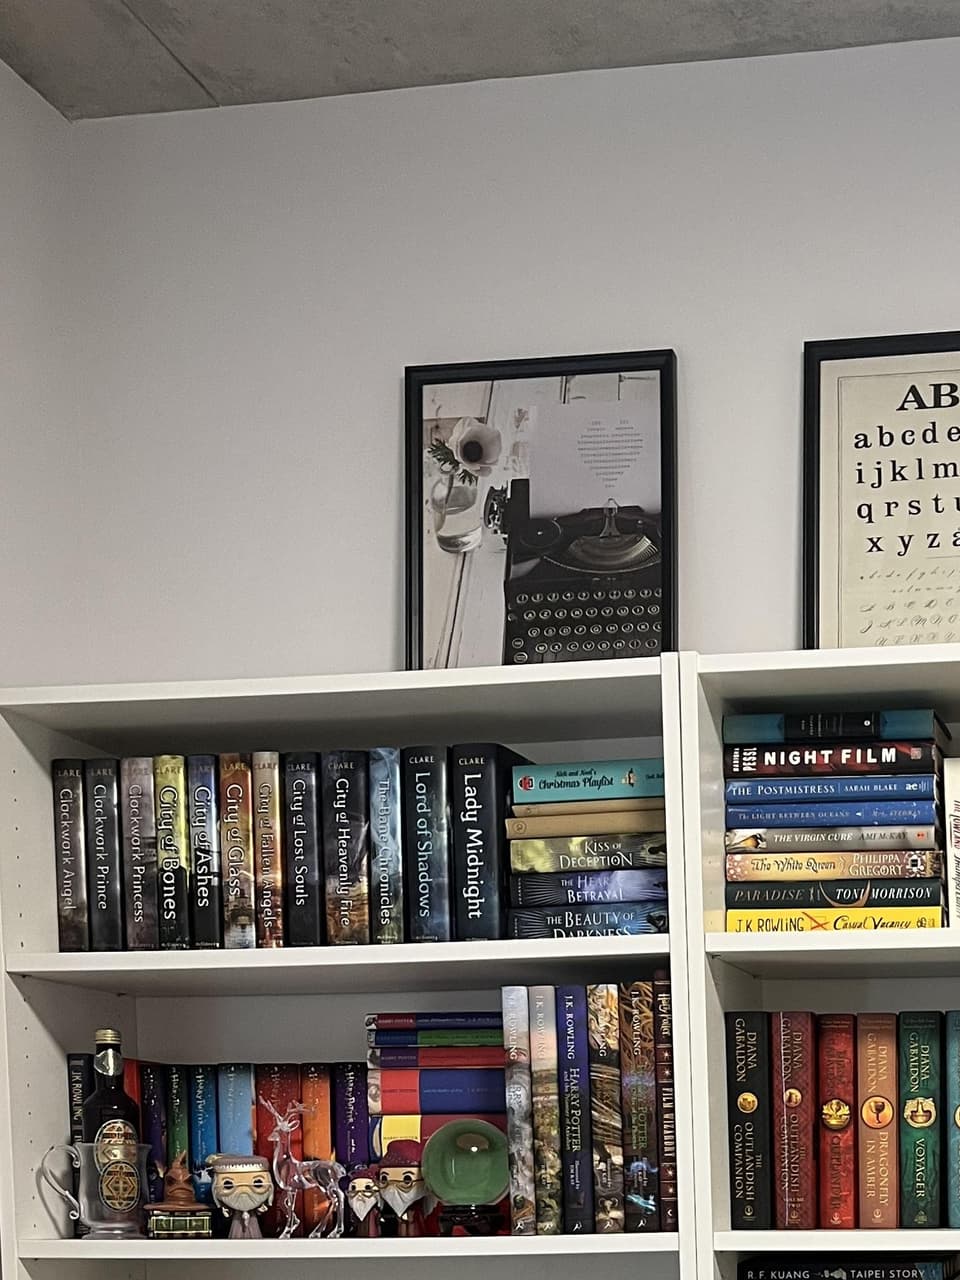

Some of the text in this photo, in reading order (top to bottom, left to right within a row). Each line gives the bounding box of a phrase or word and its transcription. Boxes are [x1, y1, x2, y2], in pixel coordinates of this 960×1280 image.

[409, 755, 435, 764] CLARE
[764, 748, 896, 766] NIGHT FILM
[158, 784, 178, 829] City
[192, 786, 212, 830] City
[413, 772, 430, 812] Lord
[732, 785, 835, 796] THE POSTMISTRESS
[461, 773, 485, 919] Lady Midnight
[774, 833, 854, 842] THE VIRGIN CURE
[195, 850, 212, 907] Ashes
[416, 840, 433, 918] Shadows
[559, 853, 633, 869] DECEPTION
[162, 856, 180, 921] Bones
[835, 887, 932, 900] TONI MORRISON
[566, 1013, 576, 1059] ROWLING
[914, 1138, 925, 1198] VOYAGER
[770, 1269, 925, 1279] KUANG TAIPEI STORY
